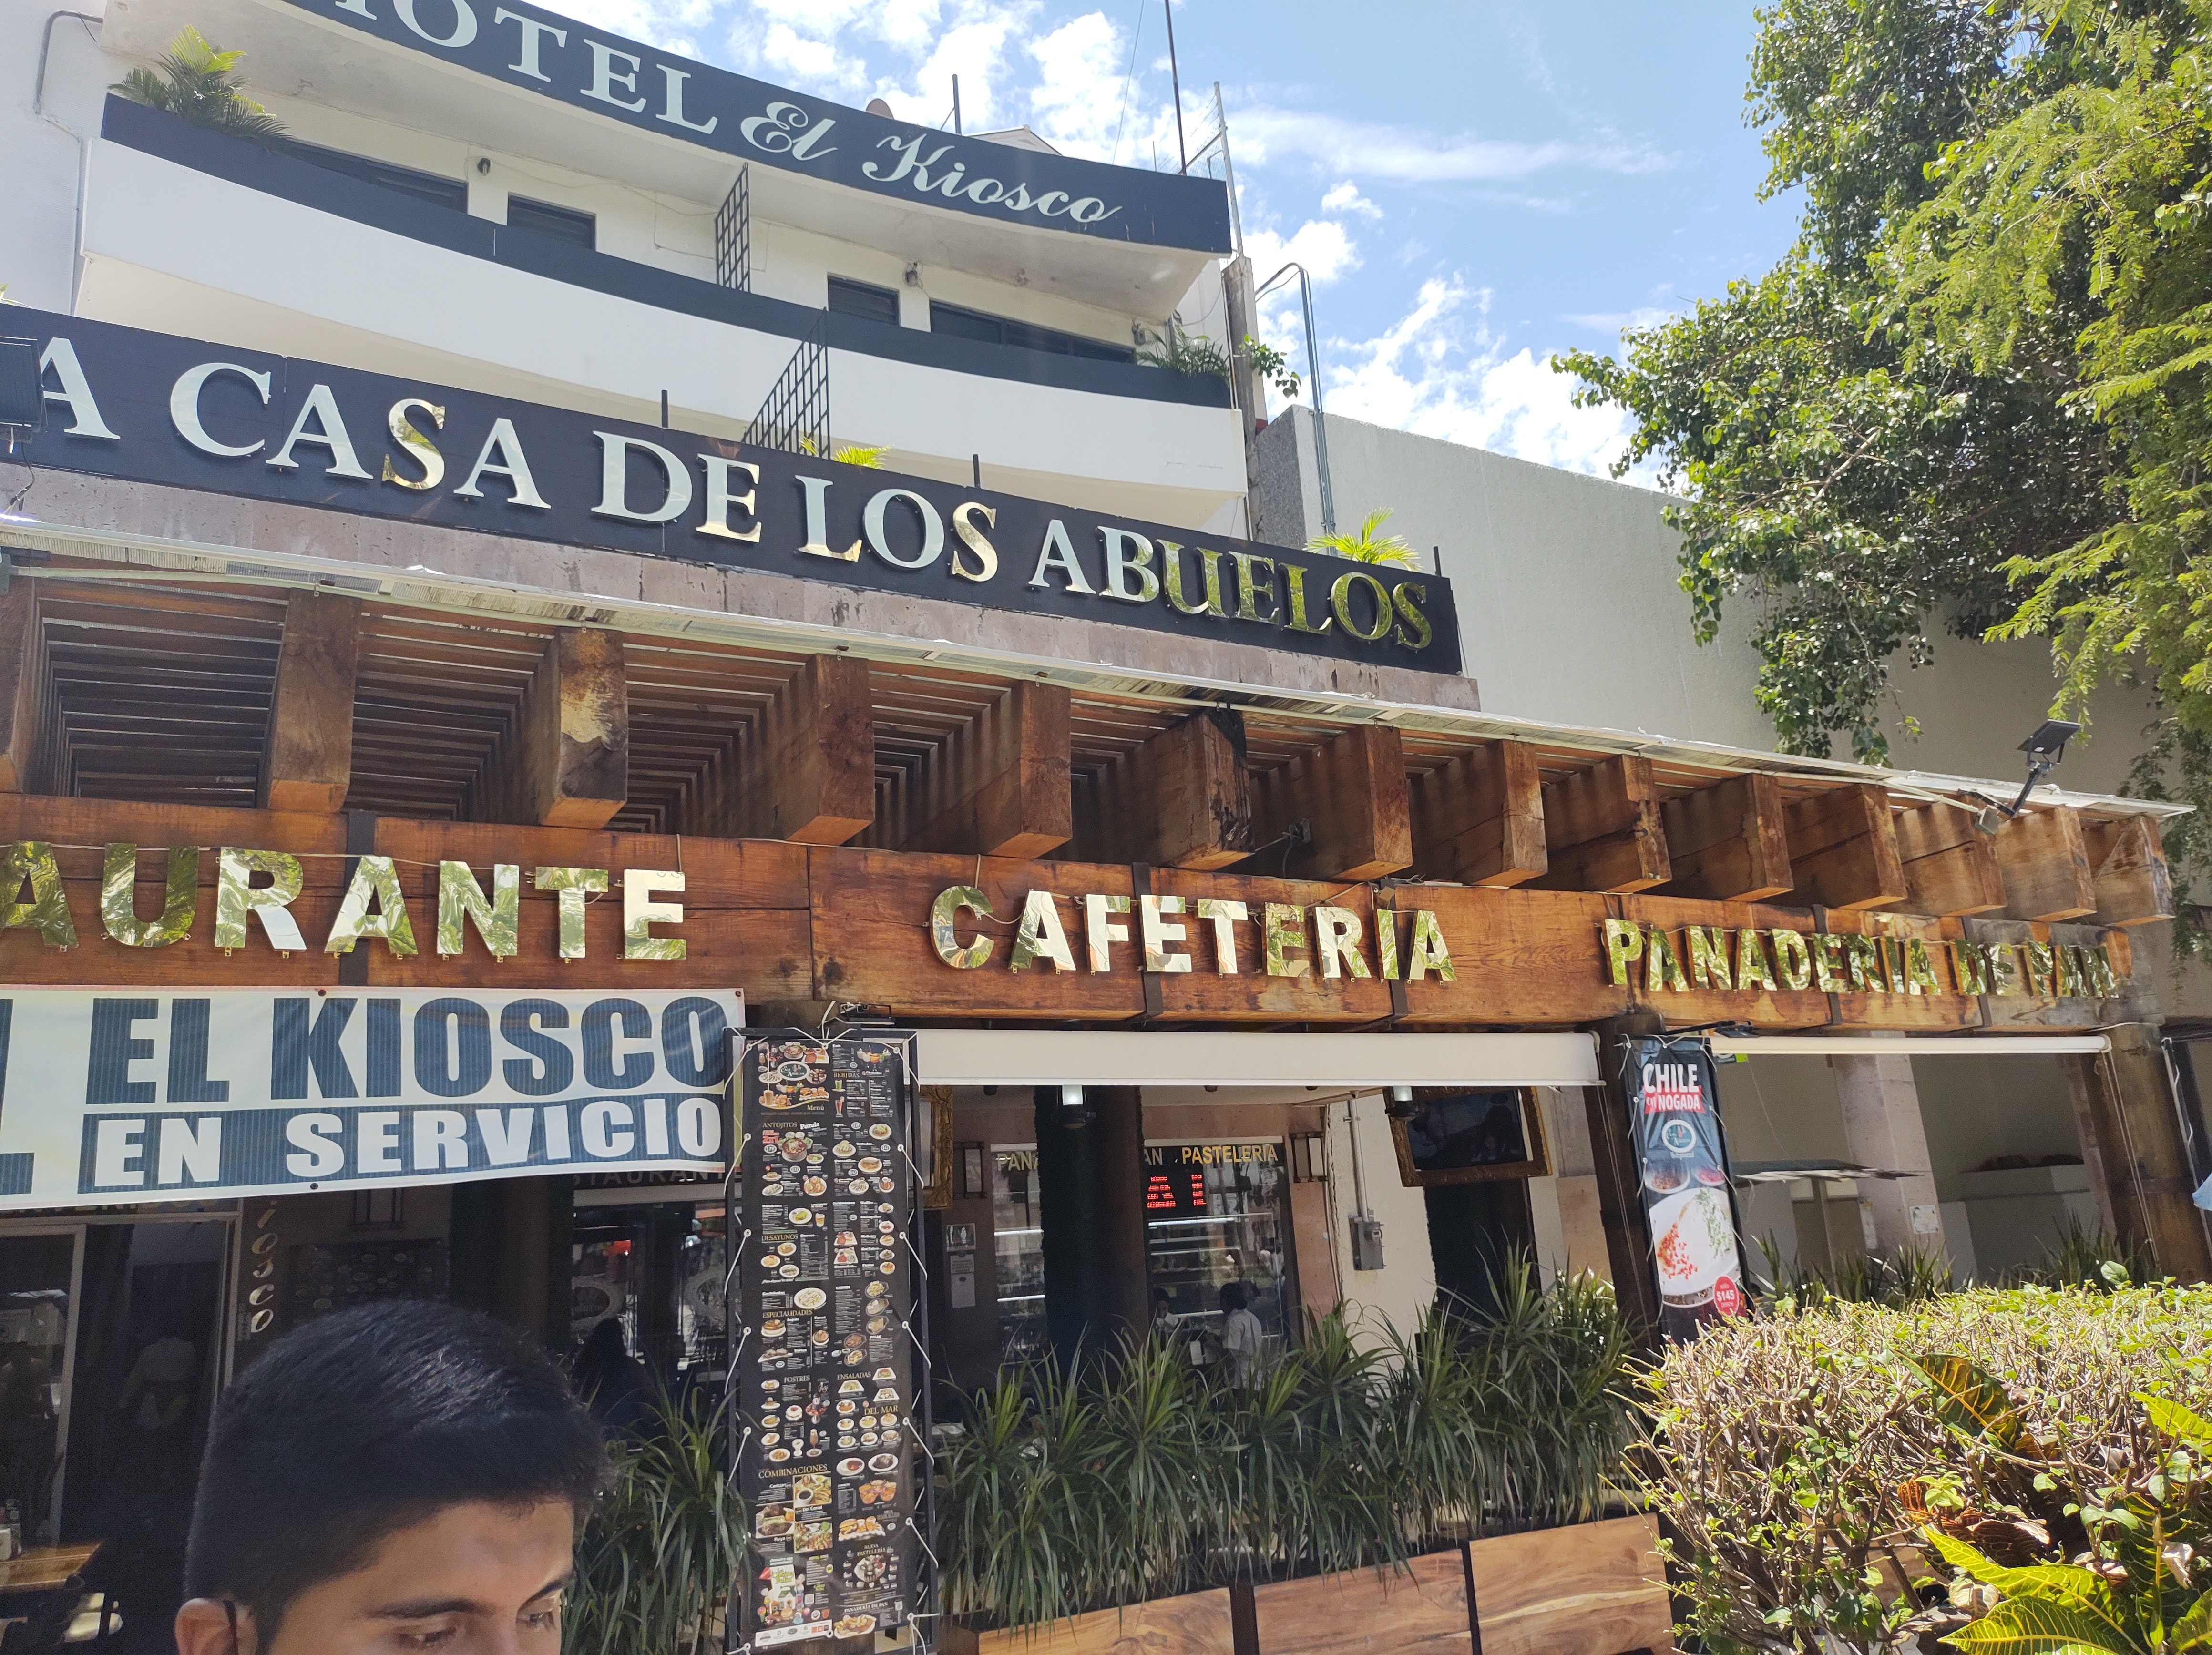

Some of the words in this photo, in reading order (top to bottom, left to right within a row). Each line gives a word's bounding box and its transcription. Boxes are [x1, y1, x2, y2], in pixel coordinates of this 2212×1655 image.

[335, 0, 718, 135] OTEL
[740, 102, 838, 161] El
[862, 133, 1123, 223] Kiosco
[170, 362, 551, 509] CASA
[591, 430, 762, 543] DE
[795, 475, 998, 582] LOS
[1028, 519, 1432, 649] ABUELOS
[86, 998, 230, 1104] EL
[270, 996, 727, 1100] KIOSCO
[1643, 1063, 1700, 1093] CHILE
[1658, 1094, 1700, 1111] NOGADA
[94, 1117, 222, 1187] EN
[286, 1097, 721, 1177] SERVICIO
[1182, 1144, 1278, 1165] PASTELERIA
[1716, 1289, 1735, 1303] $145
[763, 1309, 813, 1318] ESPECIALIDADES
[837, 1371, 871, 1380] ENSALADAS
[864, 1407, 879, 1415] DEL
[881, 1405, 899, 1413] MAR
[758, 1464, 828, 1479] COMBINACIONES
